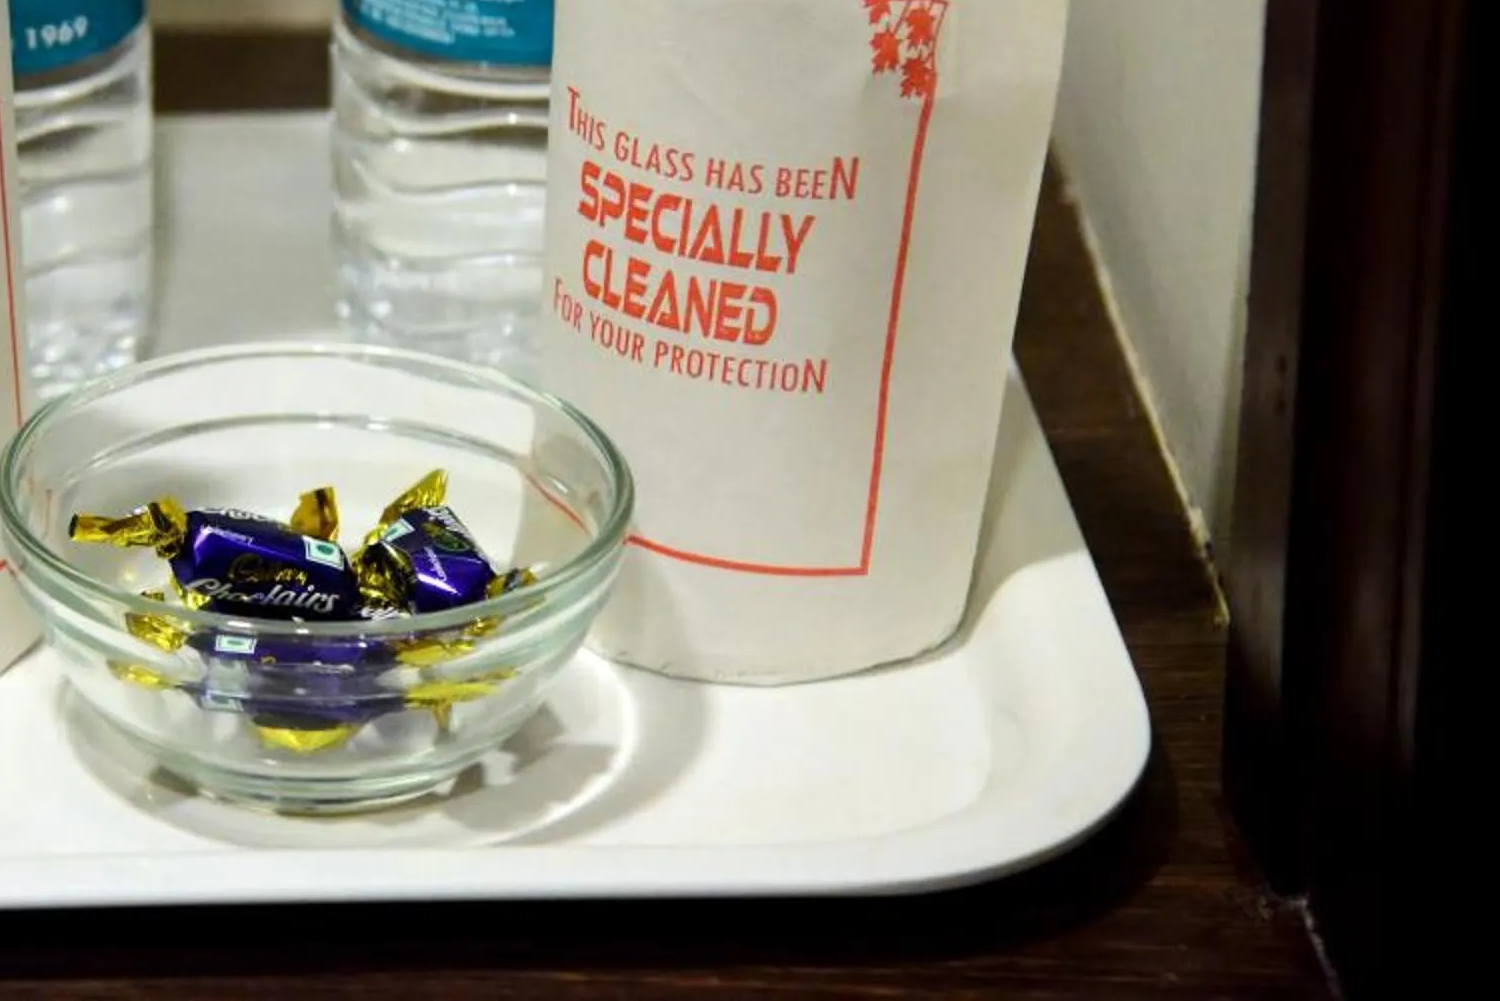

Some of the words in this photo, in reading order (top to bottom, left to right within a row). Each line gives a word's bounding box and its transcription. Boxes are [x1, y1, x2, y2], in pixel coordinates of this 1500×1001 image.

[25, 15, 88, 49] 1969
[567, 85, 606, 151] THIS
[614, 131, 695, 183] GLASS
[705, 157, 764, 194] HAS
[775, 156, 860, 200] BEEN
[577, 160, 816, 275] SPECIALLY
[554, 277, 583, 333] FOR
[589, 312, 645, 364] YOUR
[654, 341, 828, 394] PROTECTION
[582, 238, 778, 346] CLEANED
